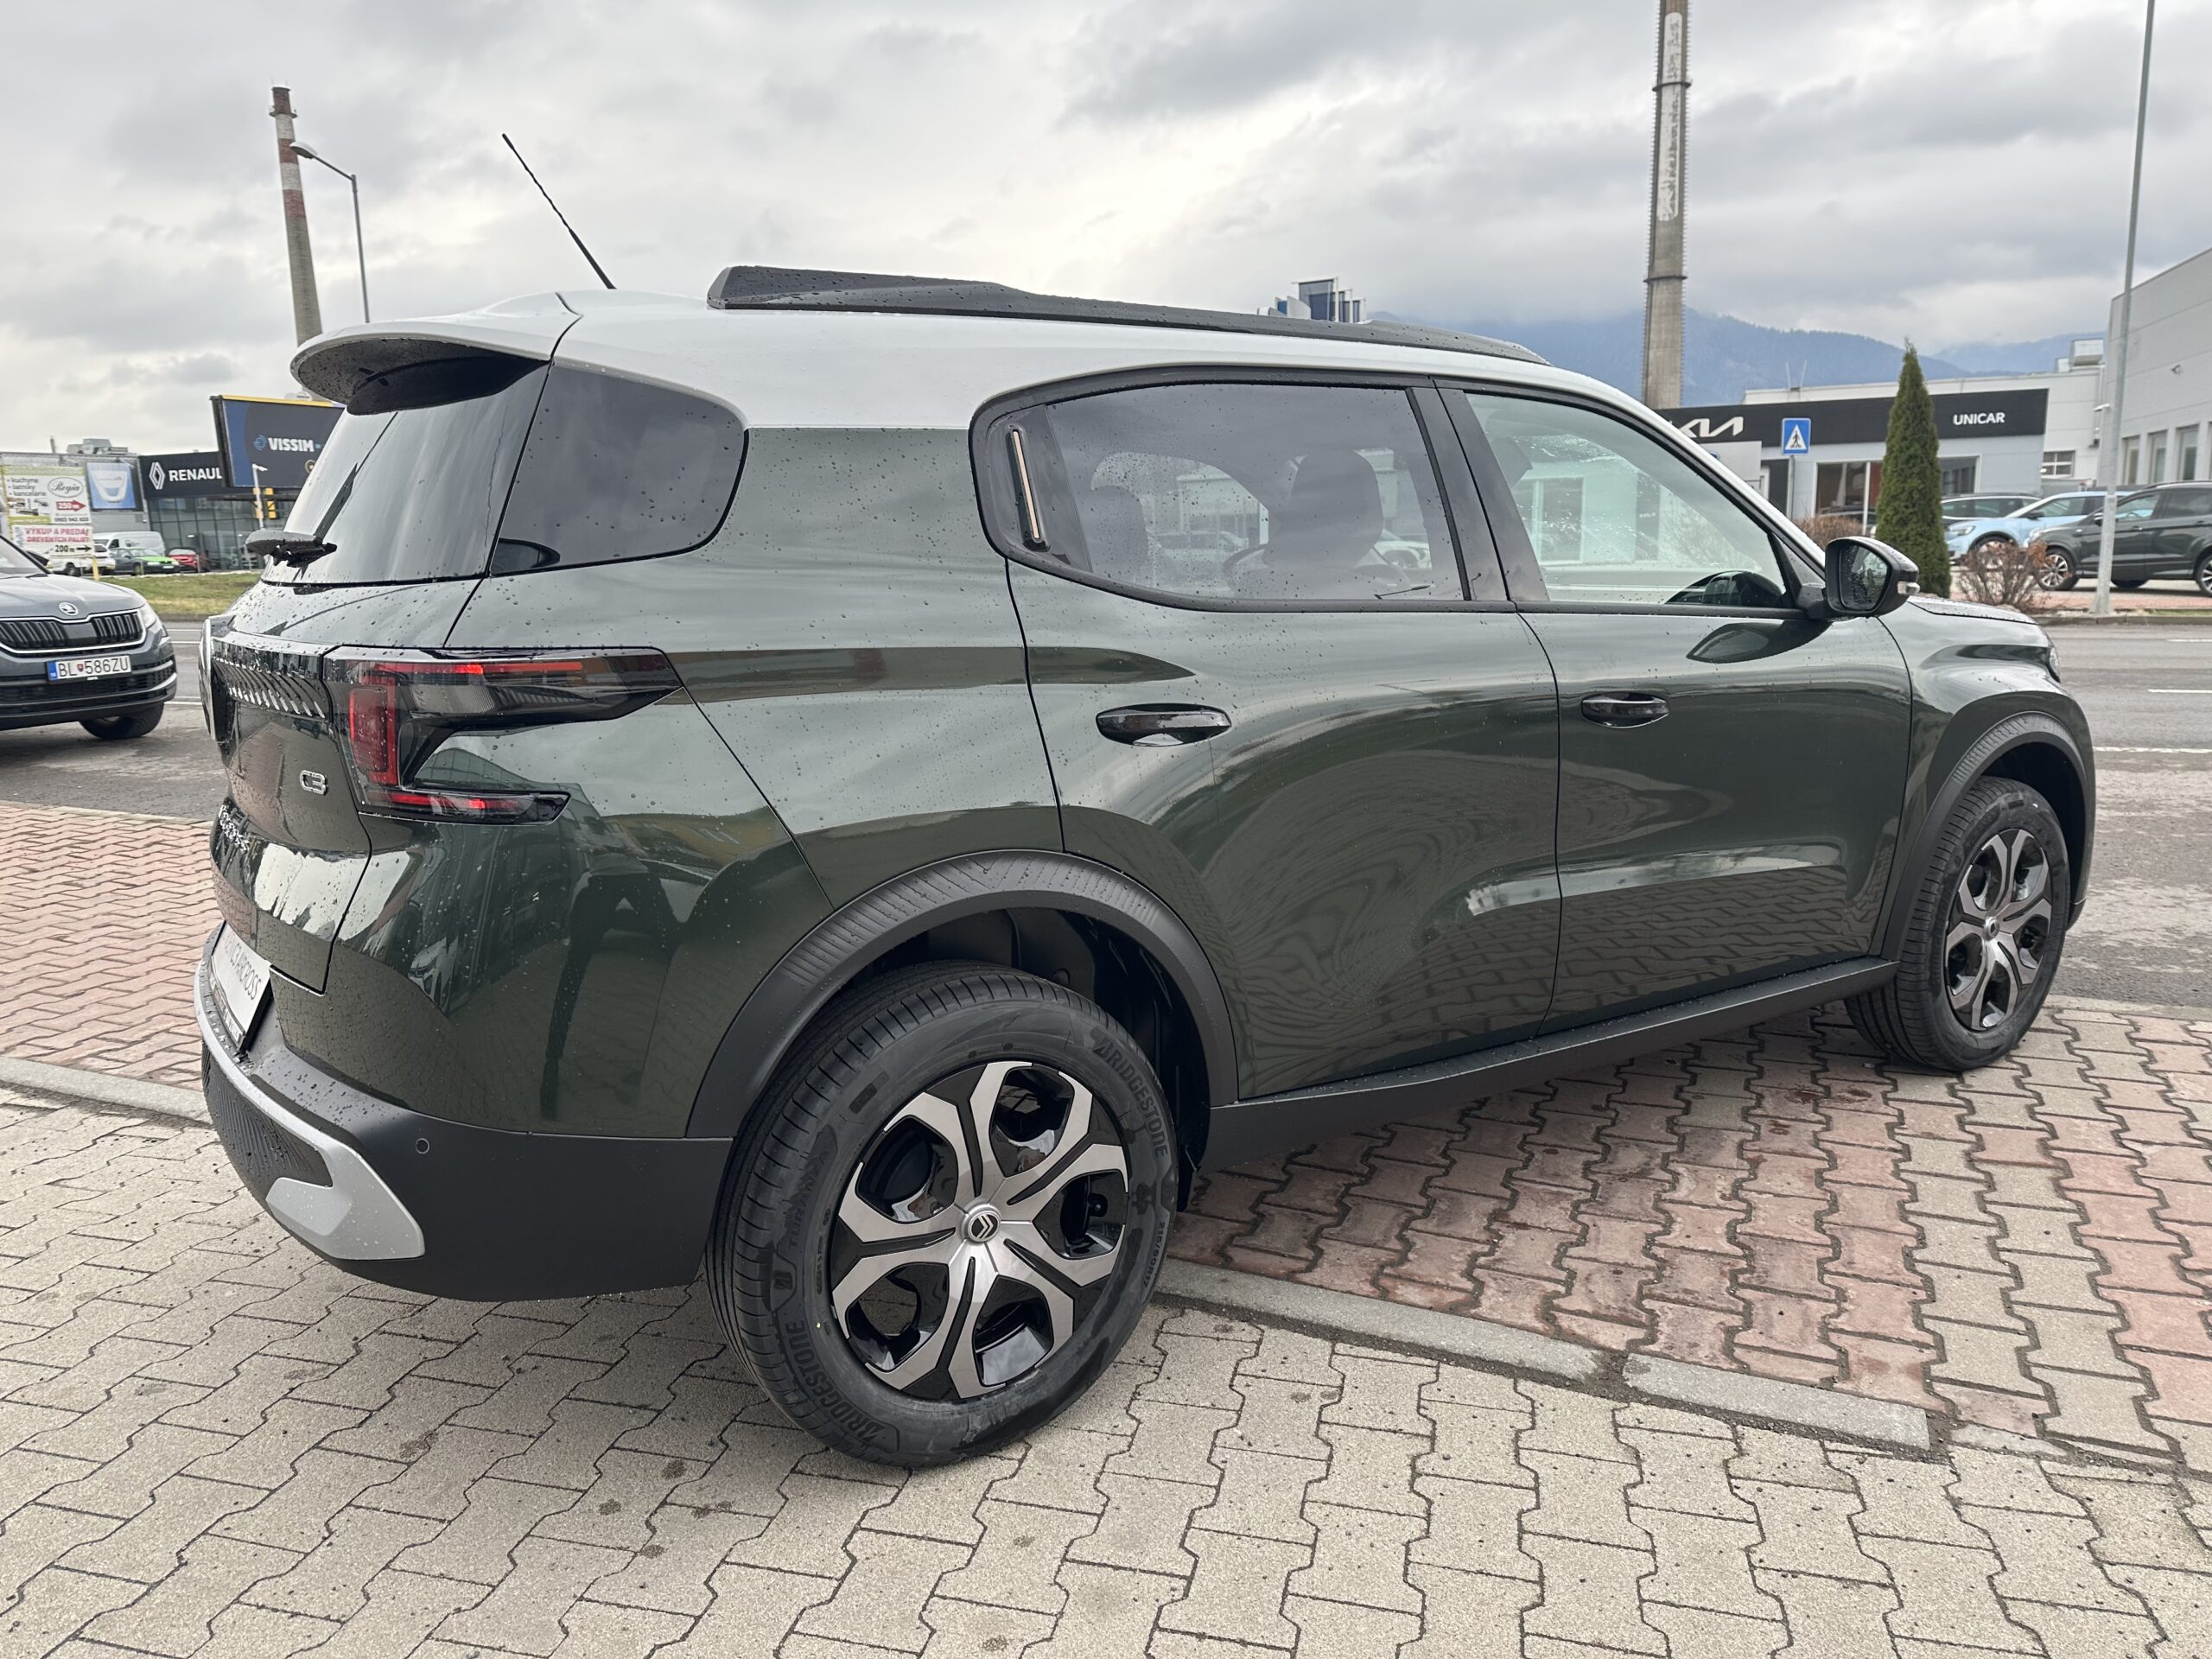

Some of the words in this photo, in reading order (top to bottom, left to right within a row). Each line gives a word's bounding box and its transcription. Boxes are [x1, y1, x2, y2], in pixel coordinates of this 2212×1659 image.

[1953, 412, 2005, 425] UNICAR
[268, 437, 315, 452] VISSIM
[168, 467, 222, 481] RENAUL
[54, 544, 68, 553] 200
[58, 663, 78, 677] BL
[84, 657, 129, 675] 586ZU
[299, 769, 326, 795] C3
[1092, 1037, 1168, 1159] BRIDGESTONE
[785, 1319, 886, 1443] BRIDGESTONE
